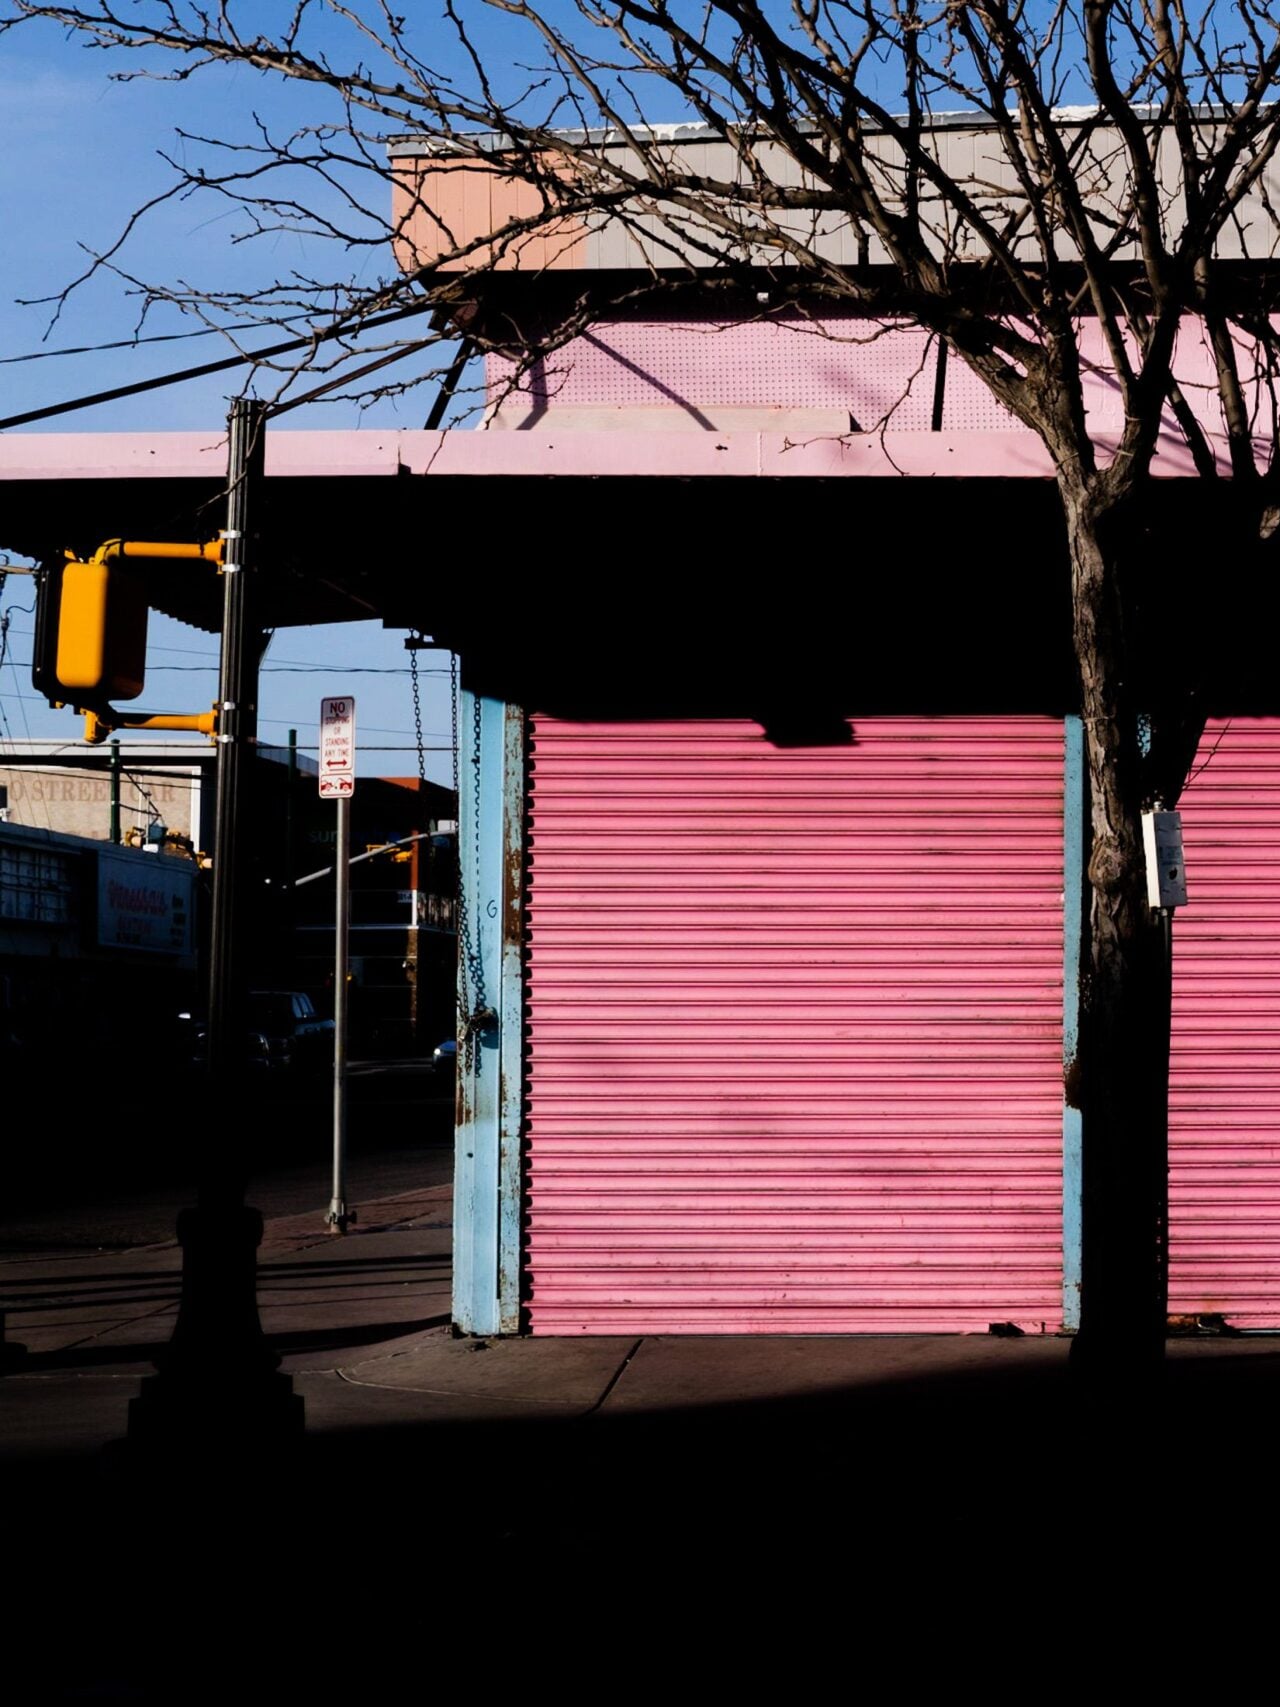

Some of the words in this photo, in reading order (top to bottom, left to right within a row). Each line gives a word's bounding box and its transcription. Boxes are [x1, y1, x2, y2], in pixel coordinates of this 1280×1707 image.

[330, 702, 345, 714] NO
[325, 716, 350, 725] STOPPING
[334, 727, 341, 735] OR
[325, 738, 349, 746] STANDING
[33, 779, 116, 802] STREE
